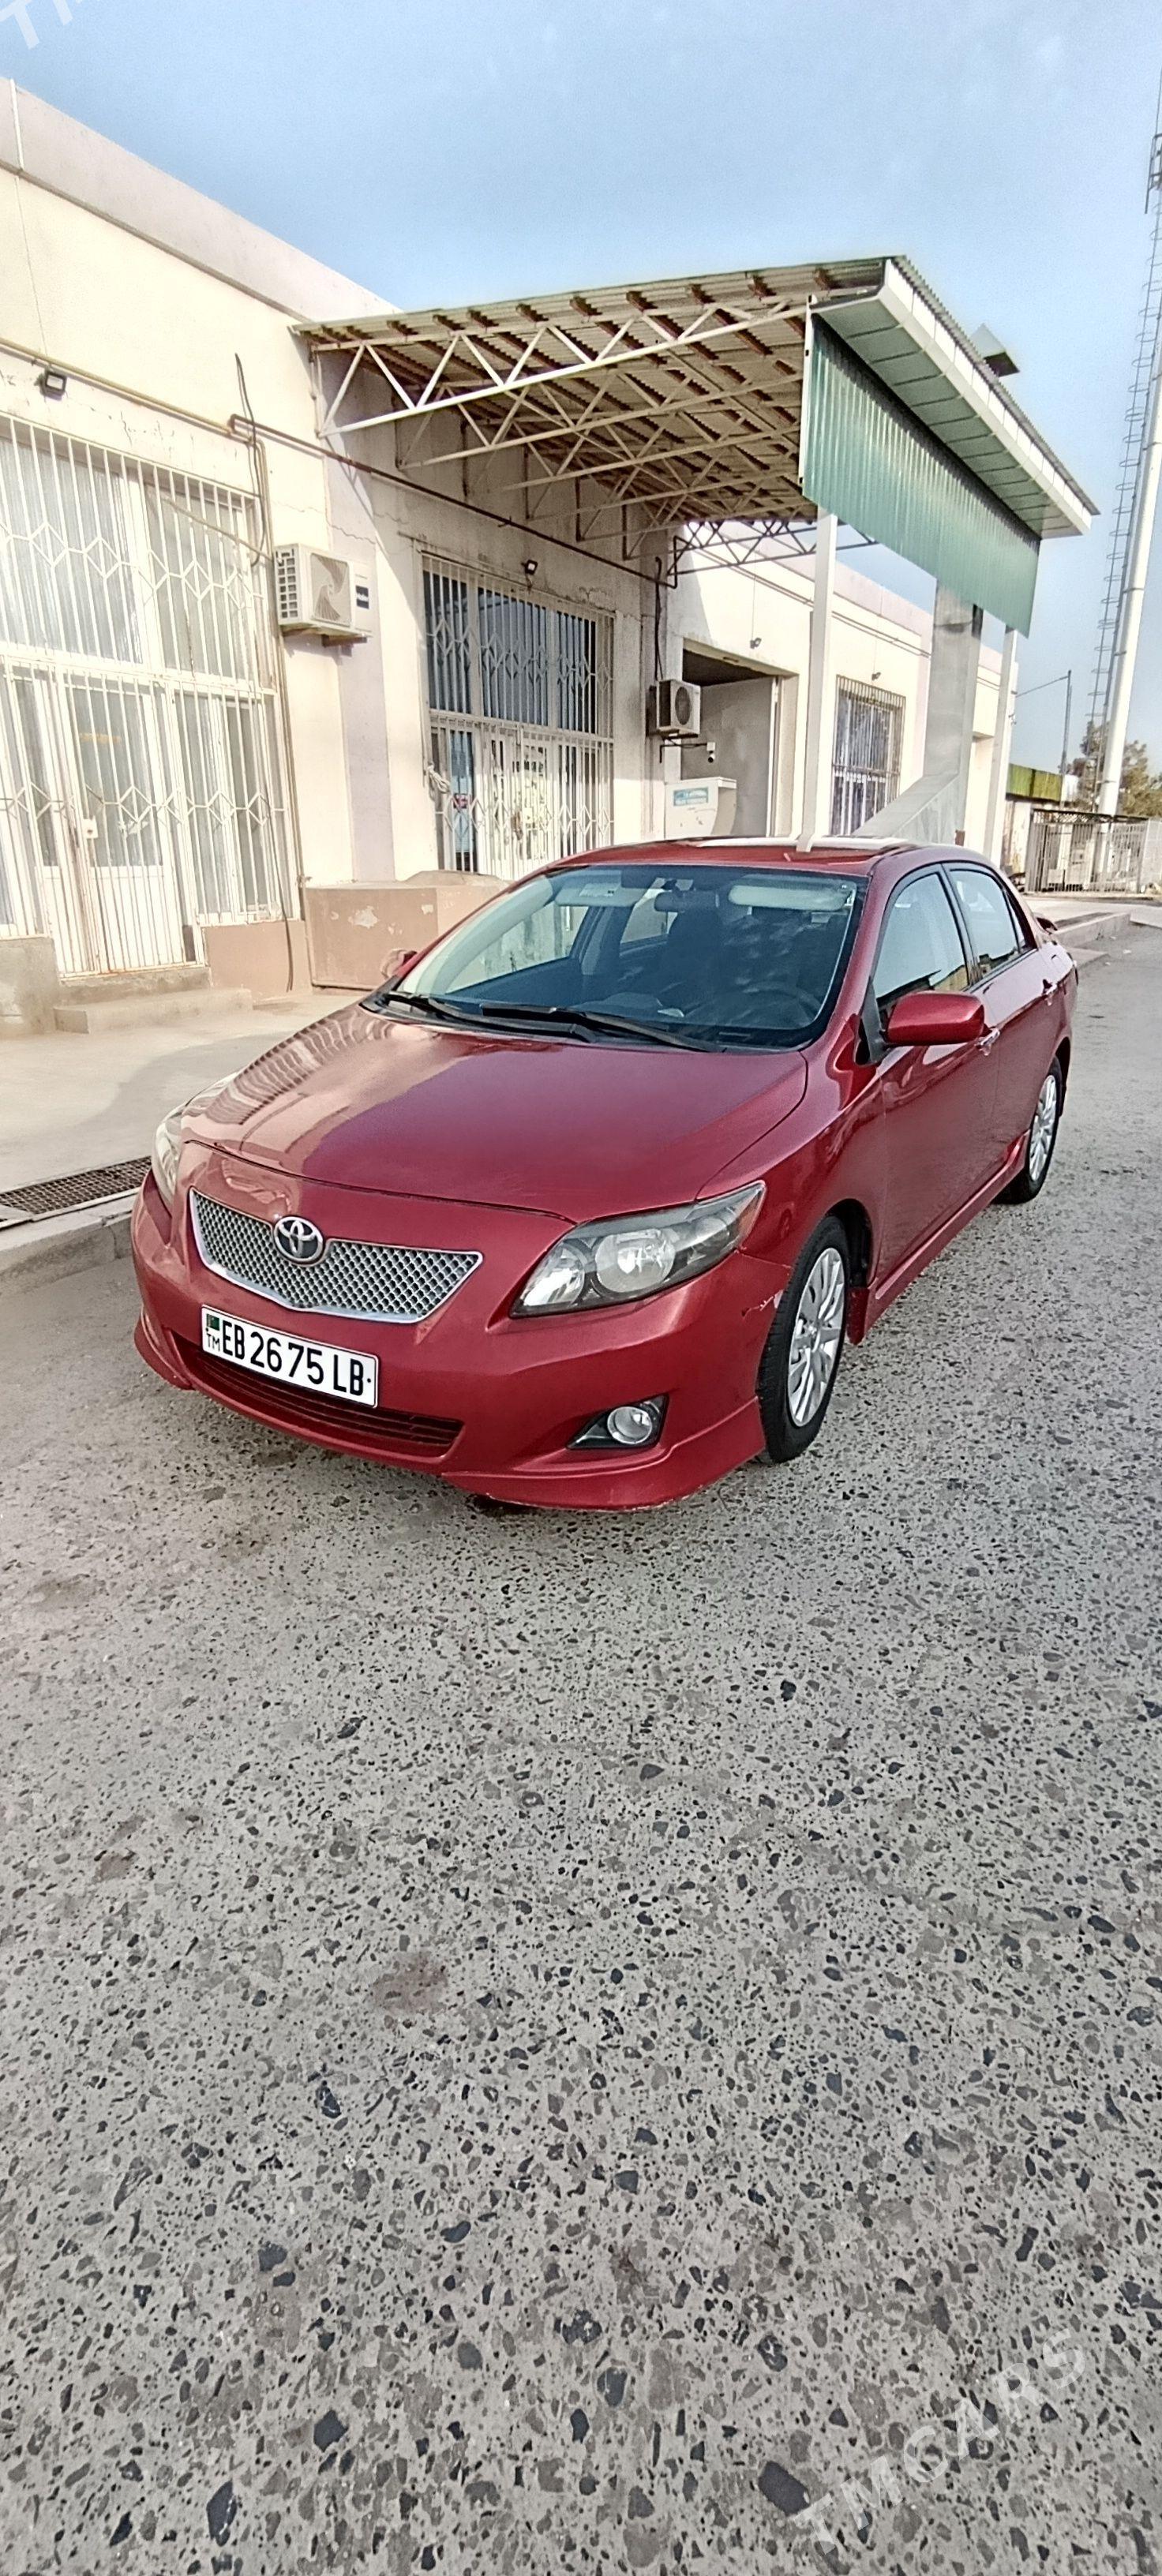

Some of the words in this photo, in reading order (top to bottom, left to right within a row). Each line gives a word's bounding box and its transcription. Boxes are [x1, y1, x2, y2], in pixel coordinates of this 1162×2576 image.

[206, 1332, 220, 1352] TM
[222, 1320, 246, 1361] EB
[249, 1331, 324, 1385] 2675
[332, 1354, 365, 1397] LB
